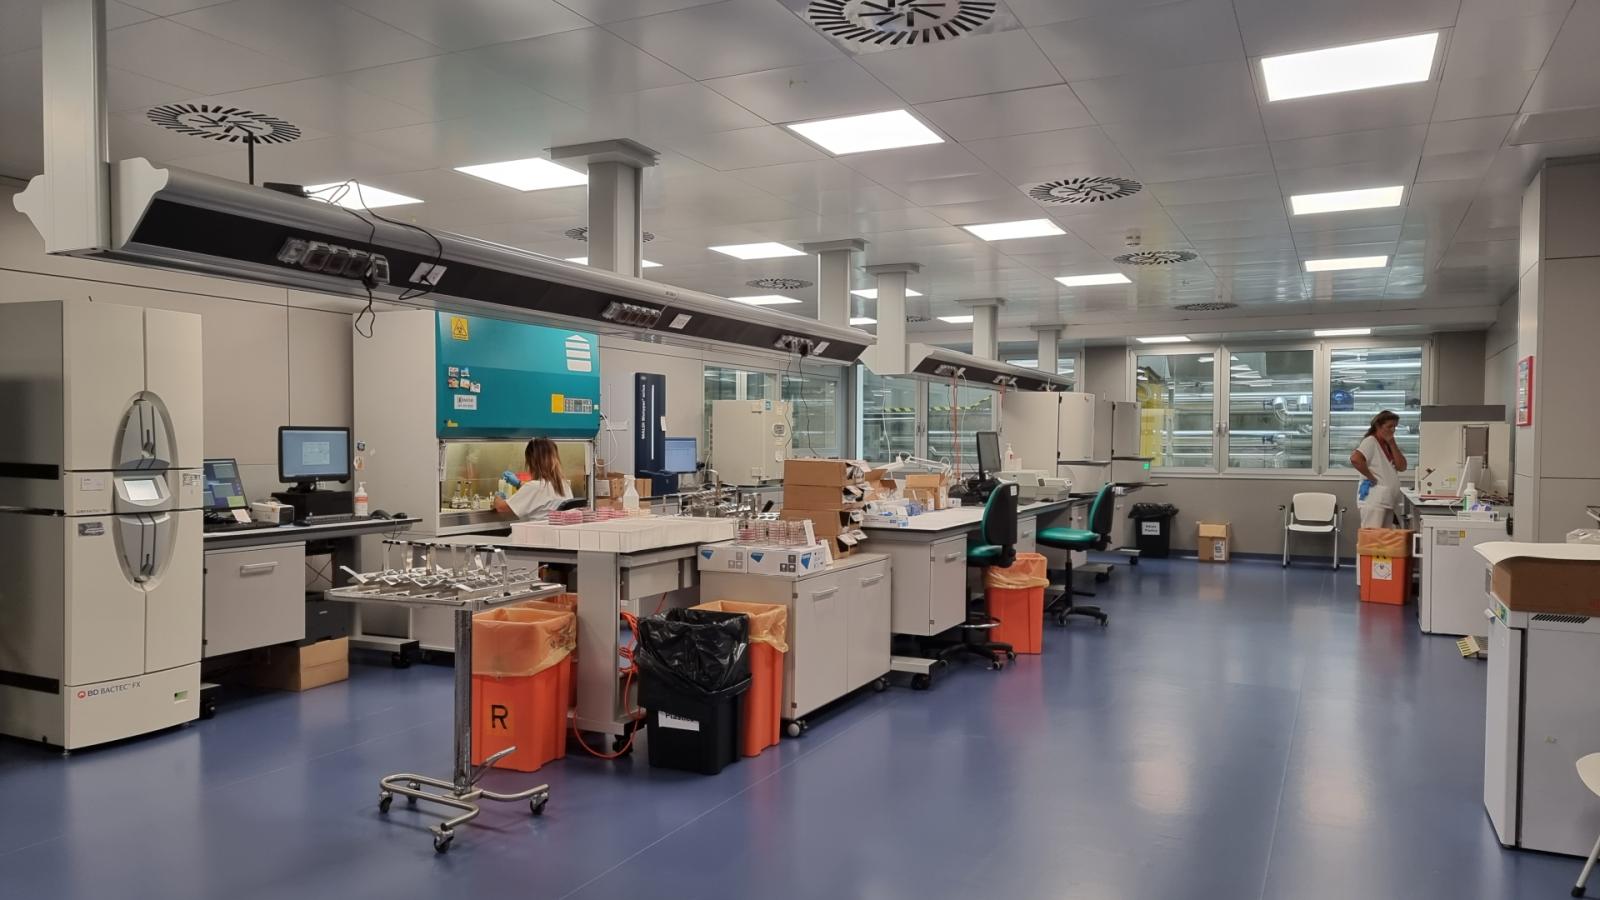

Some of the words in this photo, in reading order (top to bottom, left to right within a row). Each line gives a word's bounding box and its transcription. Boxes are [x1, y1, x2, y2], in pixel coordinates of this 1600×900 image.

[87, 689, 99, 697] BD
[132, 681, 141, 689] FX
[491, 704, 509, 730] R
